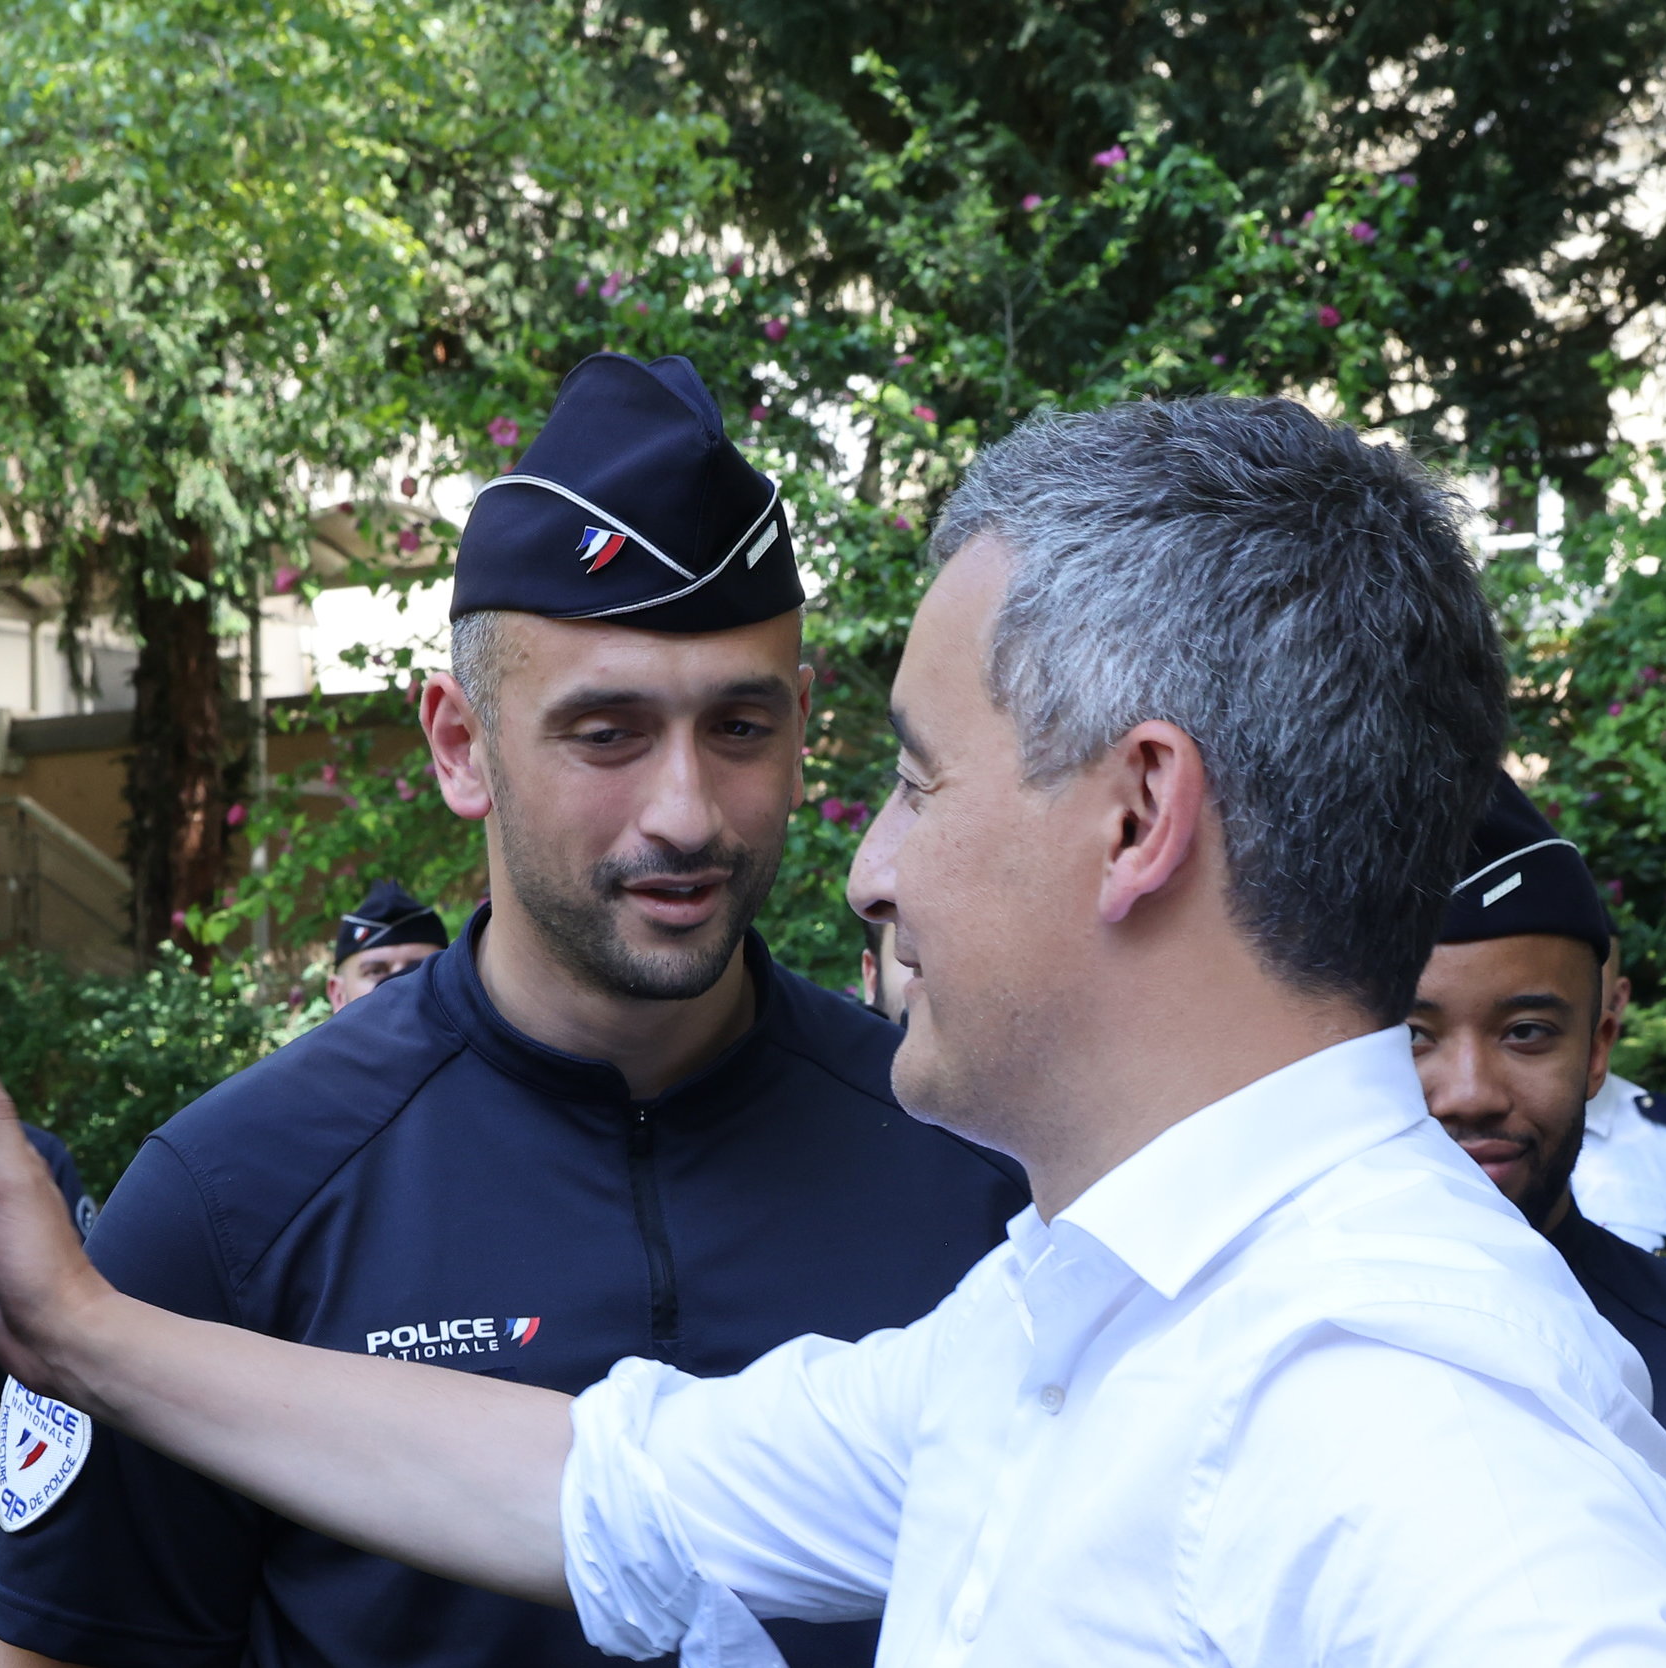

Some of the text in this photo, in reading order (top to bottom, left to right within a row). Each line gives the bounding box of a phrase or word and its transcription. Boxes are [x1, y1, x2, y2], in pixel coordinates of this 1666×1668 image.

[366, 1318, 497, 1354] POLICE
[376, 1340, 500, 1362] ATIONALE
[11, 1396, 73, 1449] NATIONALE
[0, 1404, 76, 1511] PREFECTURE DE POLICE
